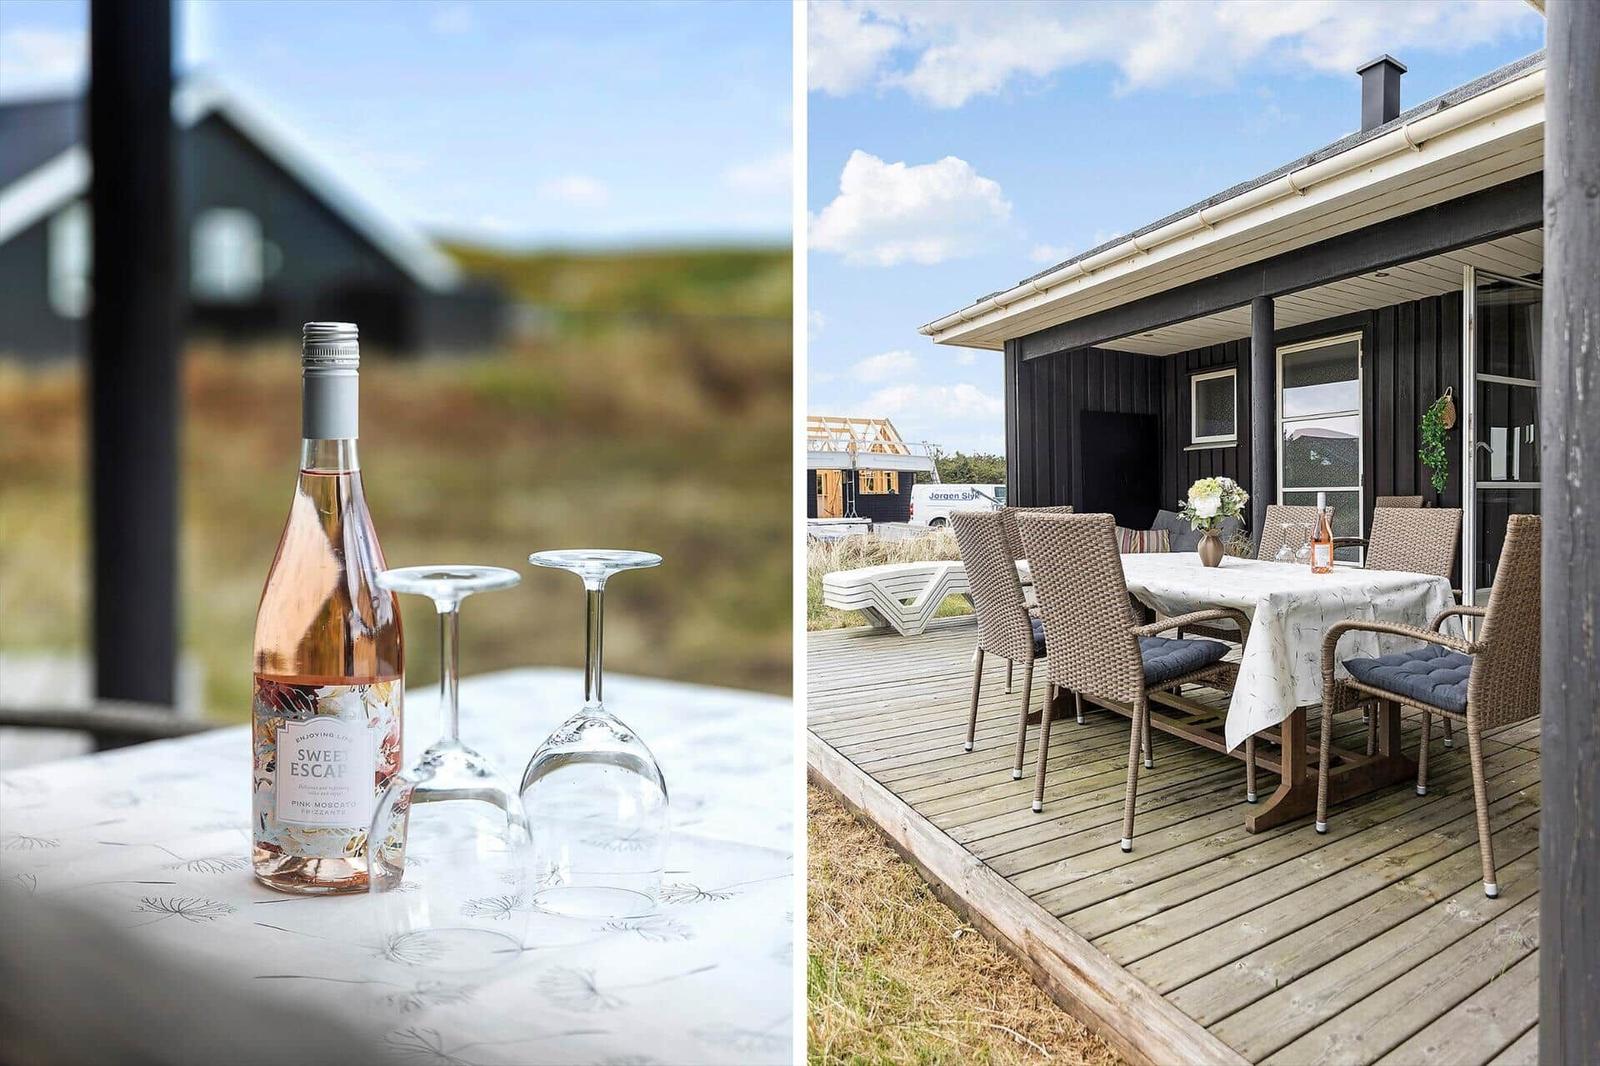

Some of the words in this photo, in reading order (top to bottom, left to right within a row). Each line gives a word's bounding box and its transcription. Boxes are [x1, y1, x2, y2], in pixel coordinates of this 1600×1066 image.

[290, 762, 352, 778] ESCAP
[291, 800, 311, 808] PINK
[314, 801, 357, 809] MOSCATO
